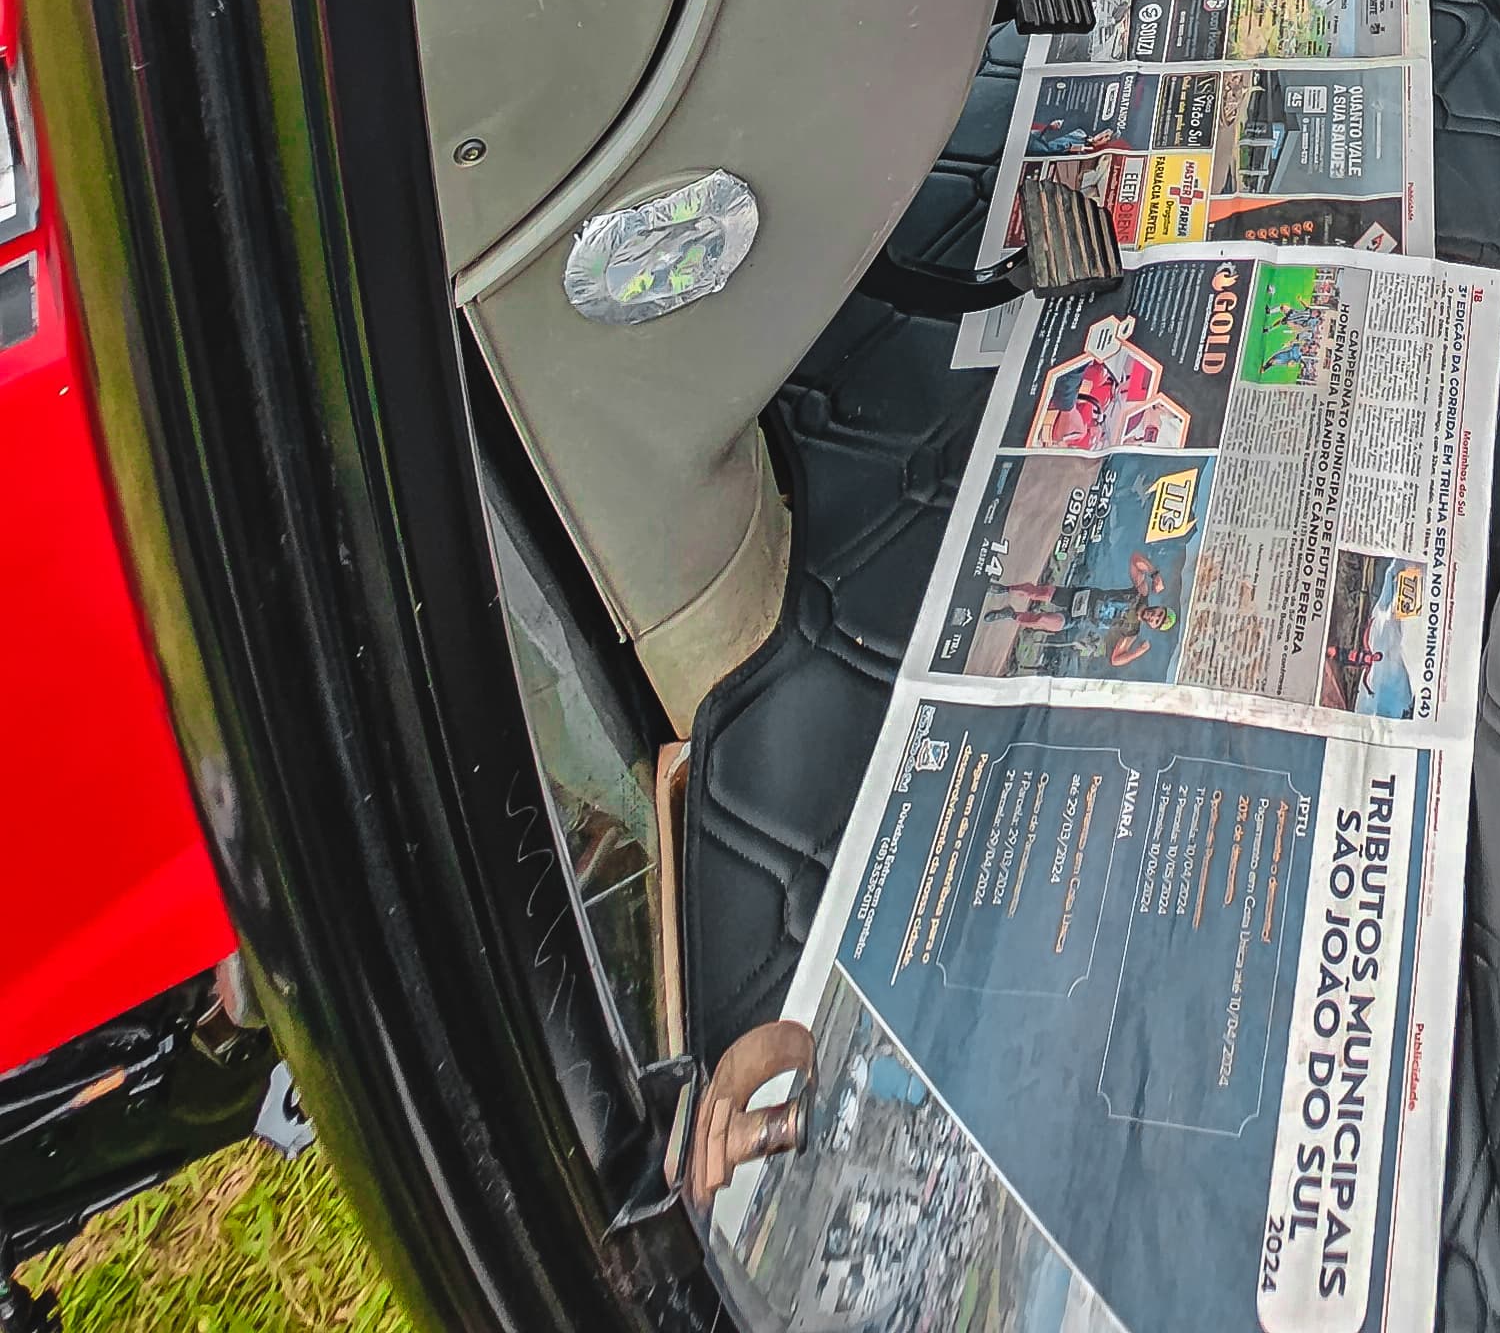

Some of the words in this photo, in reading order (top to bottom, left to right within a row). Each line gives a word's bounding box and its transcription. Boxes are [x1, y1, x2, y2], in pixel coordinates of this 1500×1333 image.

[1136, 23, 1157, 55] SOUZA
[1191, 95, 1206, 127] Visão
[1291, 92, 1302, 107] 45
[1332, 84, 1346, 94] A
[1332, 96, 1346, 122] SUA
[1348, 85, 1364, 138] QUANTO
[1187, 129, 1202, 146] Sul
[1348, 141, 1362, 177] VALE
[1150, 156, 1166, 200] FARMÁCIA
[1181, 161, 1195, 197] MASTER
[1118, 173, 1139, 242] ELETROBENS
[1177, 205, 1189, 237] FARMA
[1474, 289, 1483, 303] 18
[1201, 292, 1238, 374] GOLD
[1453, 301, 1466, 351] EDIÇÃO
[1328, 304, 1350, 396] HOMENAGEIA
[1450, 354, 1461, 373] DA
[1338, 329, 1360, 428] CAMPEONATO
[1444, 377, 1459, 440] CORRIDA
[1318, 400, 1338, 472] LEANDRO
[1443, 445, 1453, 464] EM
[1459, 430, 1471, 481] Morrinhos
[1097, 469, 1117, 511] 32K
[1314, 476, 1326, 498] DE
[1325, 432, 1345, 515] MUNICIPAL
[1459, 484, 1467, 498] do
[1437, 469, 1451, 523] TRILHA
[1457, 500, 1466, 517] Sul
[1304, 501, 1323, 576] CÂNDIDO
[1322, 519, 1334, 543] DE
[1433, 527, 1446, 568] SERÁ
[984, 539, 1009, 577] 14
[1311, 546, 1331, 622] FUTEBOL
[1431, 573, 1442, 597] NO
[1291, 581, 1311, 654] PEREIRA
[1423, 602, 1439, 682] DOMINGO
[1418, 687, 1432, 718] (14)
[967, 752, 989, 792] Pague
[1069, 774, 1082, 796] até
[934, 744, 973, 855] desenvolvimento
[964, 794, 975, 816] em
[1079, 775, 1103, 850] Pagamento
[1116, 769, 1140, 839] ALVARÁ
[1235, 795, 1250, 822] 20%
[1294, 795, 1311, 837] IPTU
[886, 802, 912, 854] Dúvidas?
[957, 818, 971, 838] dia
[1049, 797, 1078, 883] 29/03/2024
[1233, 824, 1244, 842] de
[1249, 798, 1270, 869] Pagamento
[878, 855, 895, 886] Entre
[927, 857, 941, 874] da
[972, 828, 1000, 906] 29/04/2024
[992, 828, 1019, 905] 29/03/2024
[1073, 852, 1085, 874] em
[1329, 808, 1363, 900] SÃO
[871, 887, 885, 908] em
[918, 876, 934, 915] nossa
[935, 851, 961, 916] contribua
[1139, 842, 1162, 914] 10/06/2024
[1176, 843, 1198, 915] 10/04/2024
[1246, 872, 1258, 893] em
[1351, 775, 1396, 981] TRIBUTOS
[853, 909, 877, 960] contato:
[922, 918, 940, 951] para
[1313, 907, 1351, 1039] JOÃO
[1407, 1023, 1425, 1112] Publicidade
[1302, 1051, 1336, 1131] DO
[1319, 995, 1377, 1298] MUNICIPAIS
[1287, 1143, 1326, 1241] SUL
[1260, 1215, 1285, 1293] 2024
